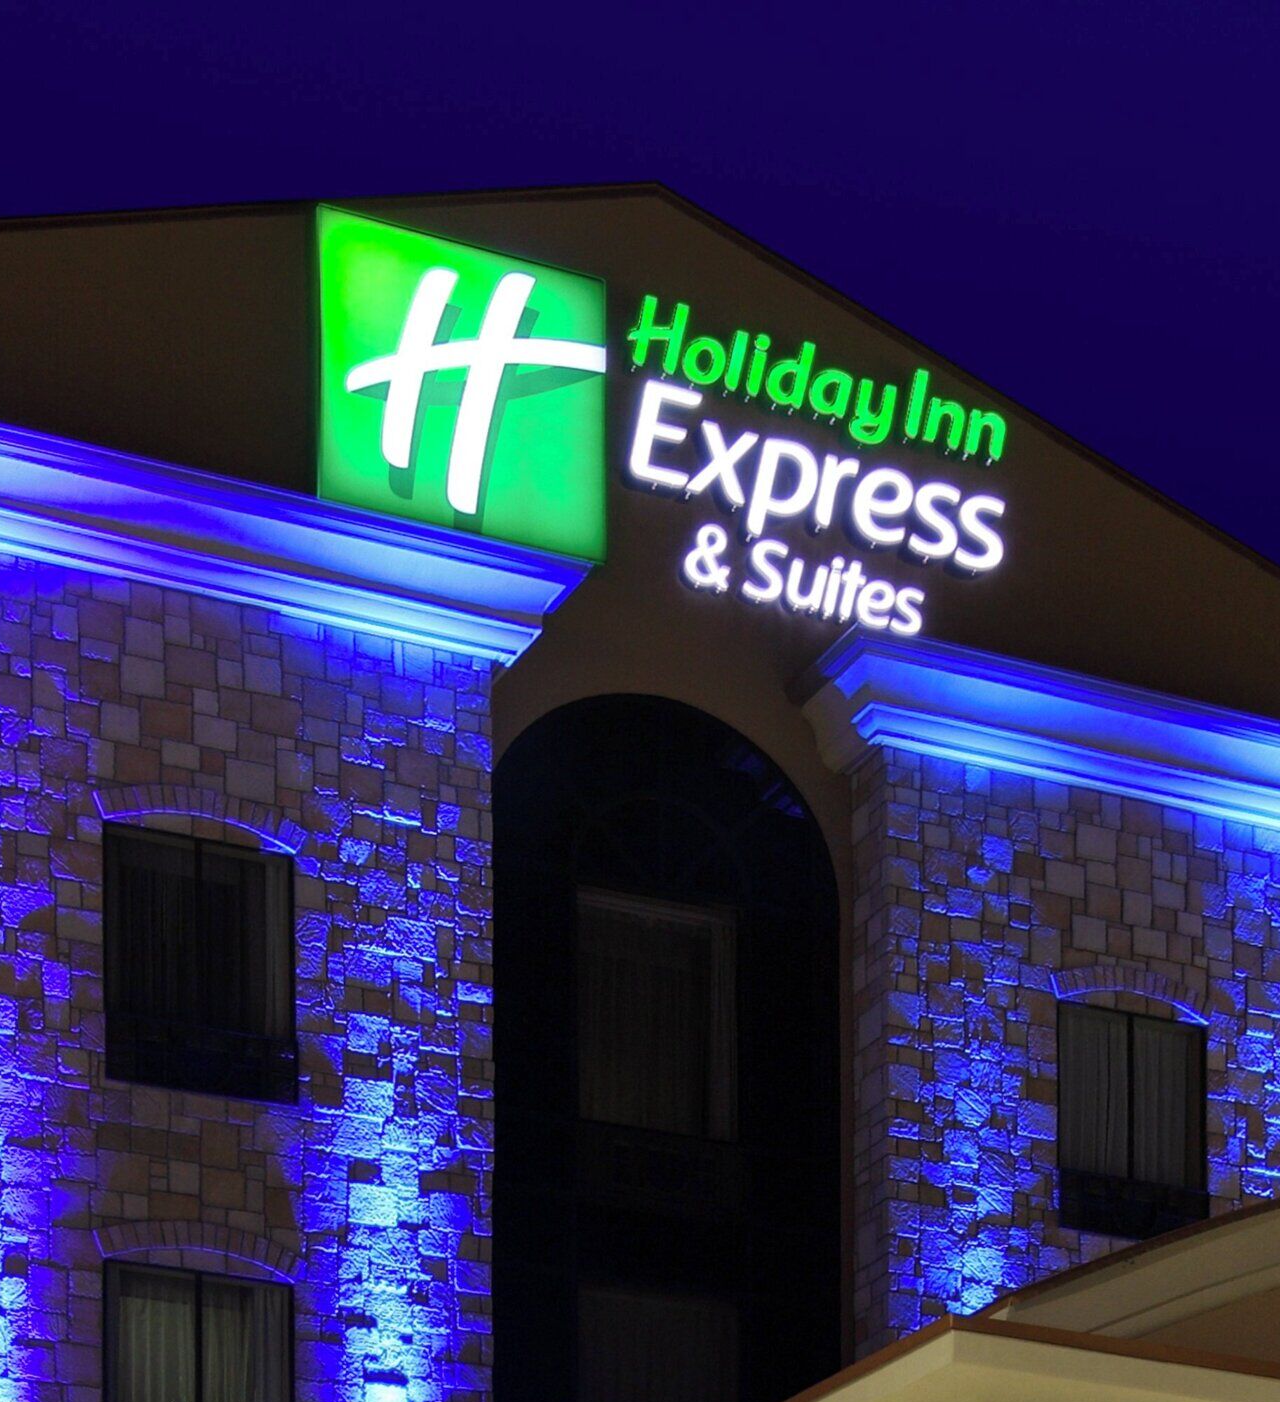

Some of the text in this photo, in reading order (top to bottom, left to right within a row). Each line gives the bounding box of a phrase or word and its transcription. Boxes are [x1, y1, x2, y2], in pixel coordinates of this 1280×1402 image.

[627, 294, 1007, 462] Holiday Inn
[629, 379, 1006, 570] Express
[683, 523, 926, 637] & Suites
